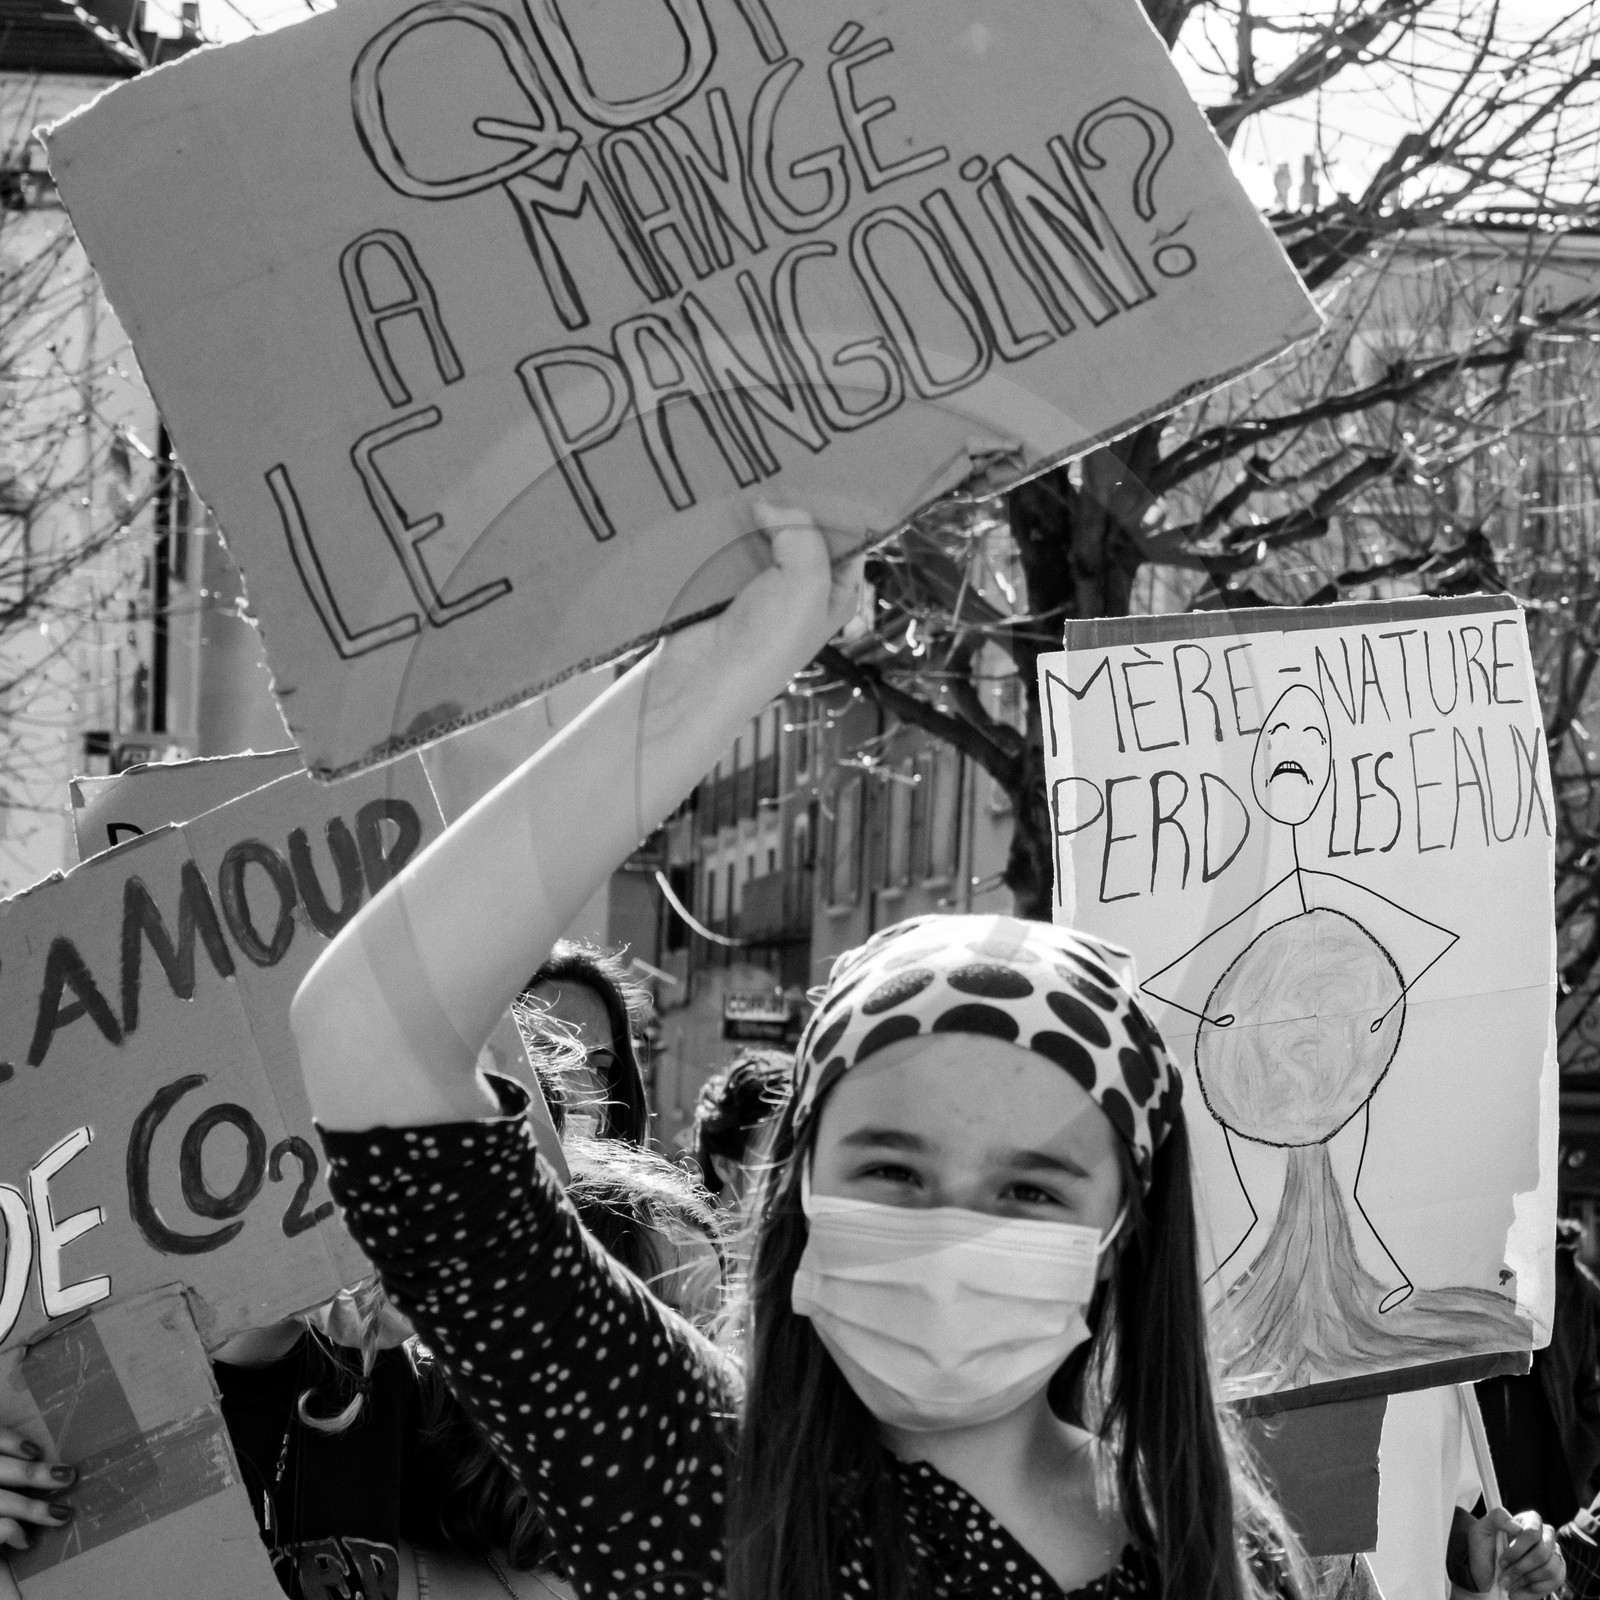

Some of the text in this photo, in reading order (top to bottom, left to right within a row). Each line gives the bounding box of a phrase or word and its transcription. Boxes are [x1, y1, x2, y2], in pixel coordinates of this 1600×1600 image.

[339, 21, 949, 408] A MANGÉ
[265, 405, 512, 659] LE
[1051, 724, 1552, 907] PERD LES EAUX
[126, 1073, 335, 1256] CO2
